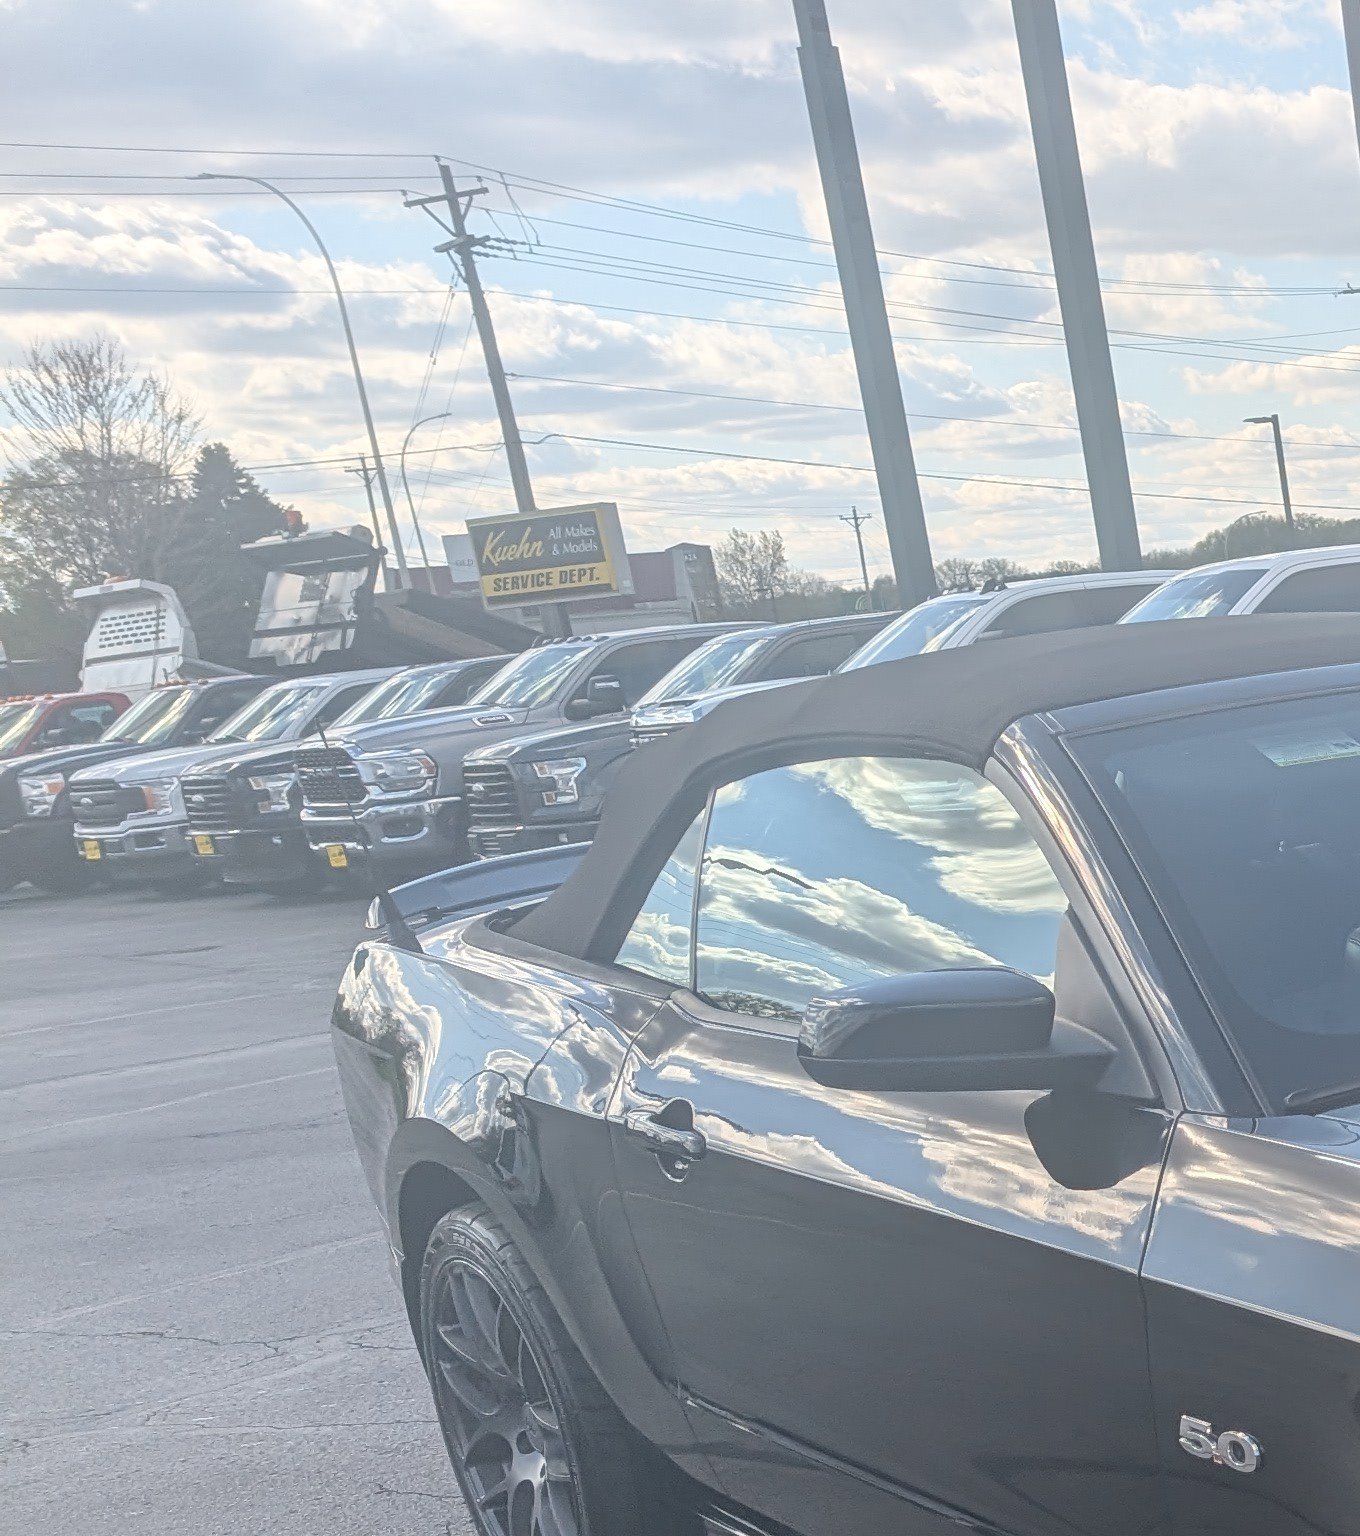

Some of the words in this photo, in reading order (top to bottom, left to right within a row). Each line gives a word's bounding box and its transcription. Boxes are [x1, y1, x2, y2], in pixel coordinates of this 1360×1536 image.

[482, 526, 543, 566] Kuehn
[549, 526, 562, 540] All
[565, 524, 596, 537] Makes
[552, 543, 560, 556] &
[562, 538, 598, 554] Models
[493, 571, 553, 592] SERVICE
[558, 566, 600, 584] DEPT.
